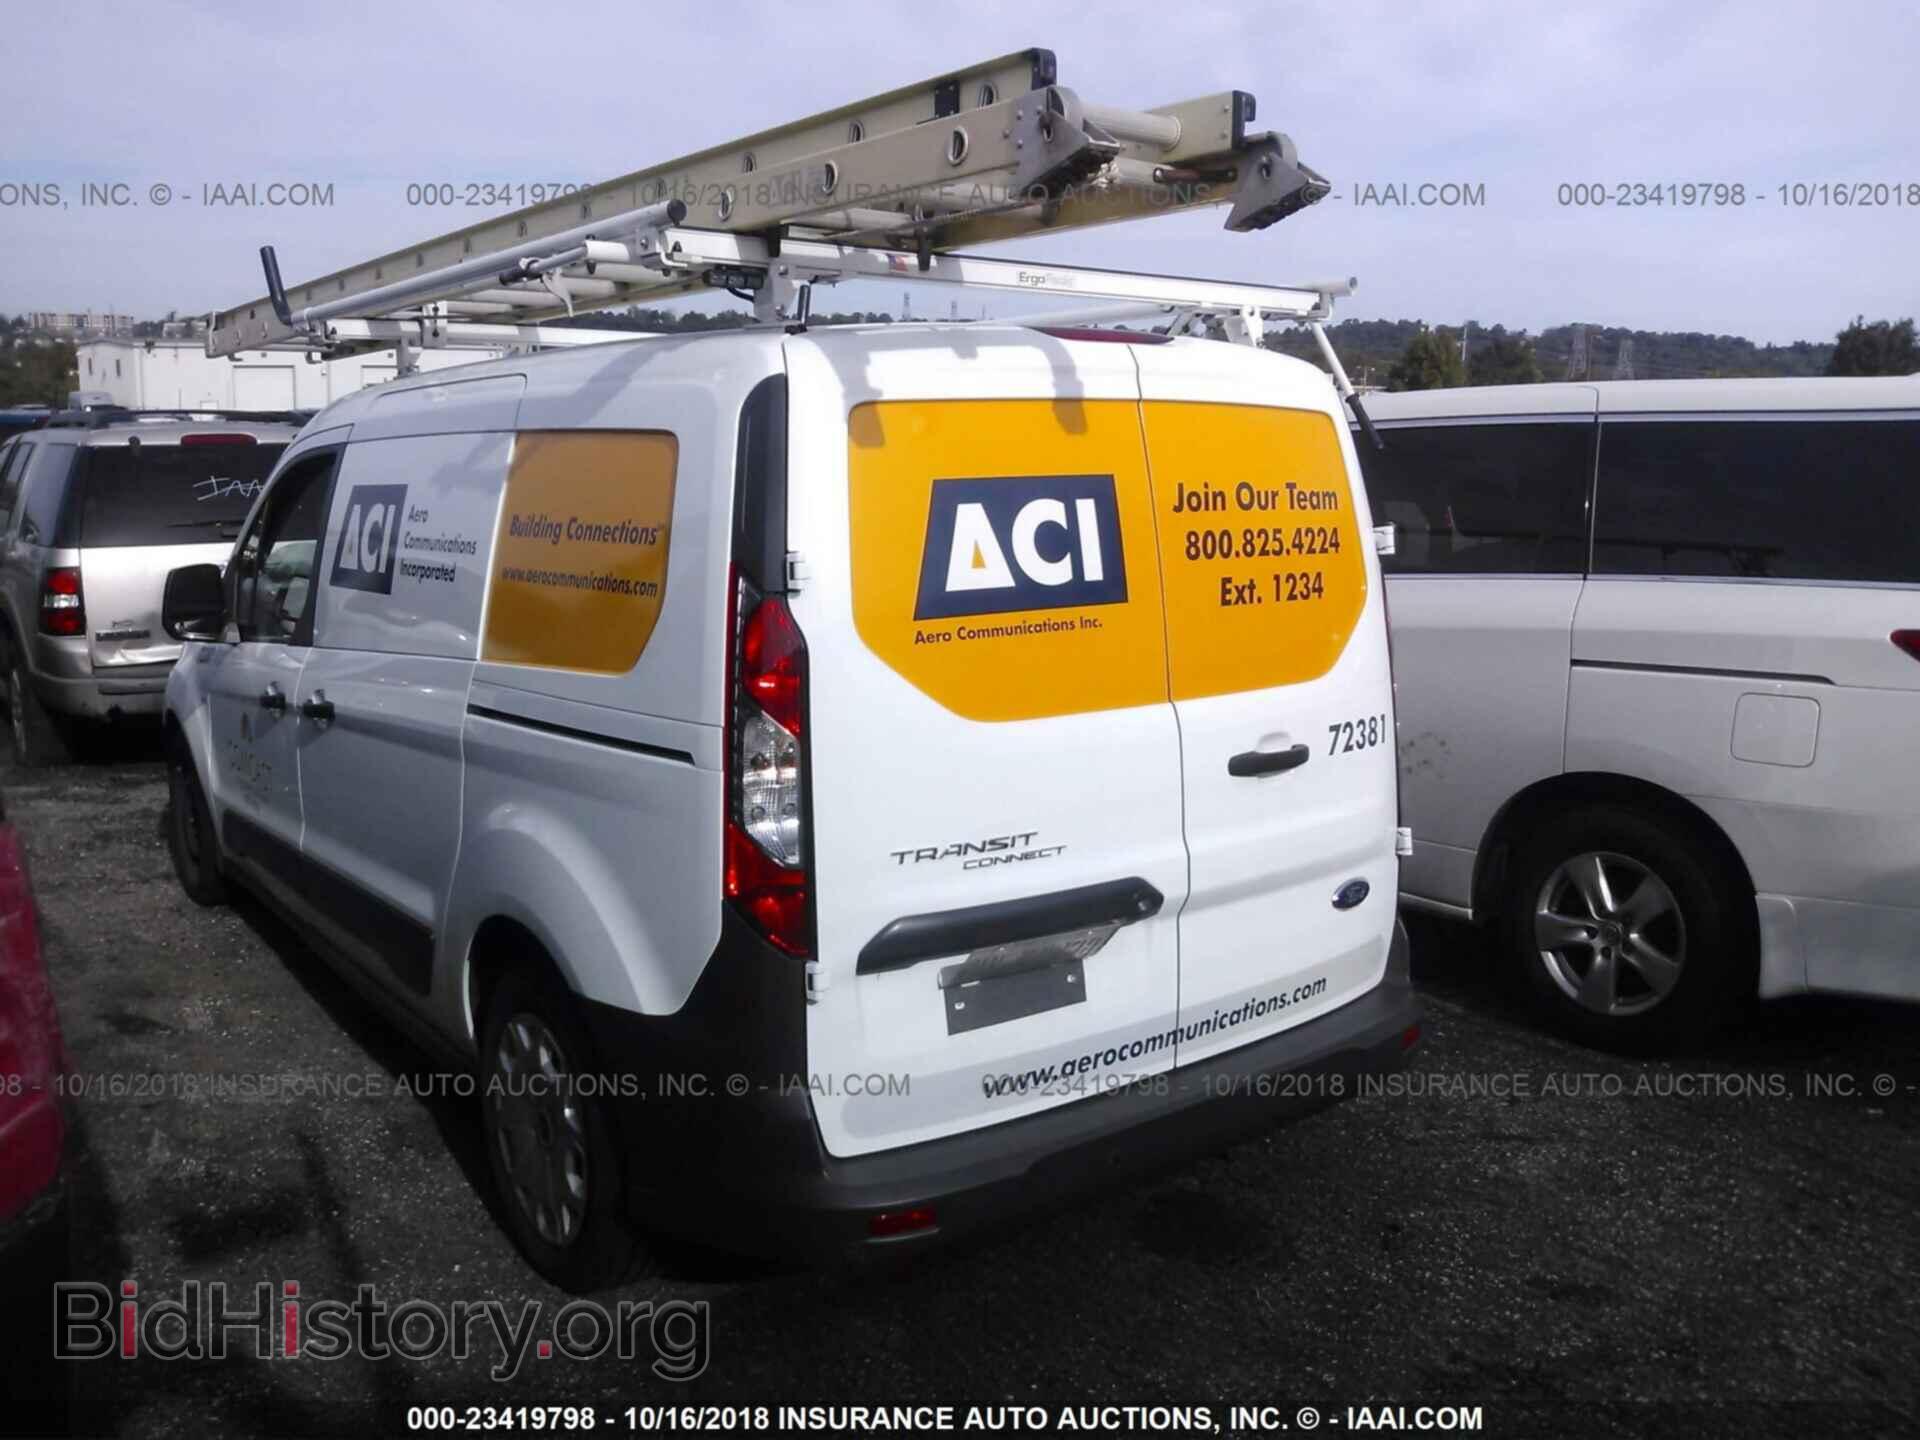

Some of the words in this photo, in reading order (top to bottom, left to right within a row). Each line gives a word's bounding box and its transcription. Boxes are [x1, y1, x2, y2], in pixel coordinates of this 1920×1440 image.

[408, 503, 429, 524] Aero
[1172, 481, 1227, 514] Join
[1235, 481, 1280, 512] Our
[1285, 481, 1339, 511] Team
[338, 503, 397, 574] ACI
[404, 531, 477, 556] Communications
[509, 513, 563, 545] Building
[566, 516, 658, 546] Connections
[945, 498, 1104, 592] ACI
[1185, 526, 1341, 561] 800.825.4224
[401, 557, 457, 584] Incorporated
[502, 566, 659, 599] www.aerocommunications.com
[1220, 576, 1263, 607] Ext.
[1272, 571, 1324, 602] 1234
[914, 629, 953, 646] Aero
[956, 617, 1076, 641] Communications
[1080, 615, 1103, 630] Inc.
[1328, 713, 1386, 757] 72381
[890, 831, 1038, 866] TRANSIT
[962, 844, 1068, 871] CONNECT
[983, 975, 1328, 1099] www.aerocommunications.com
